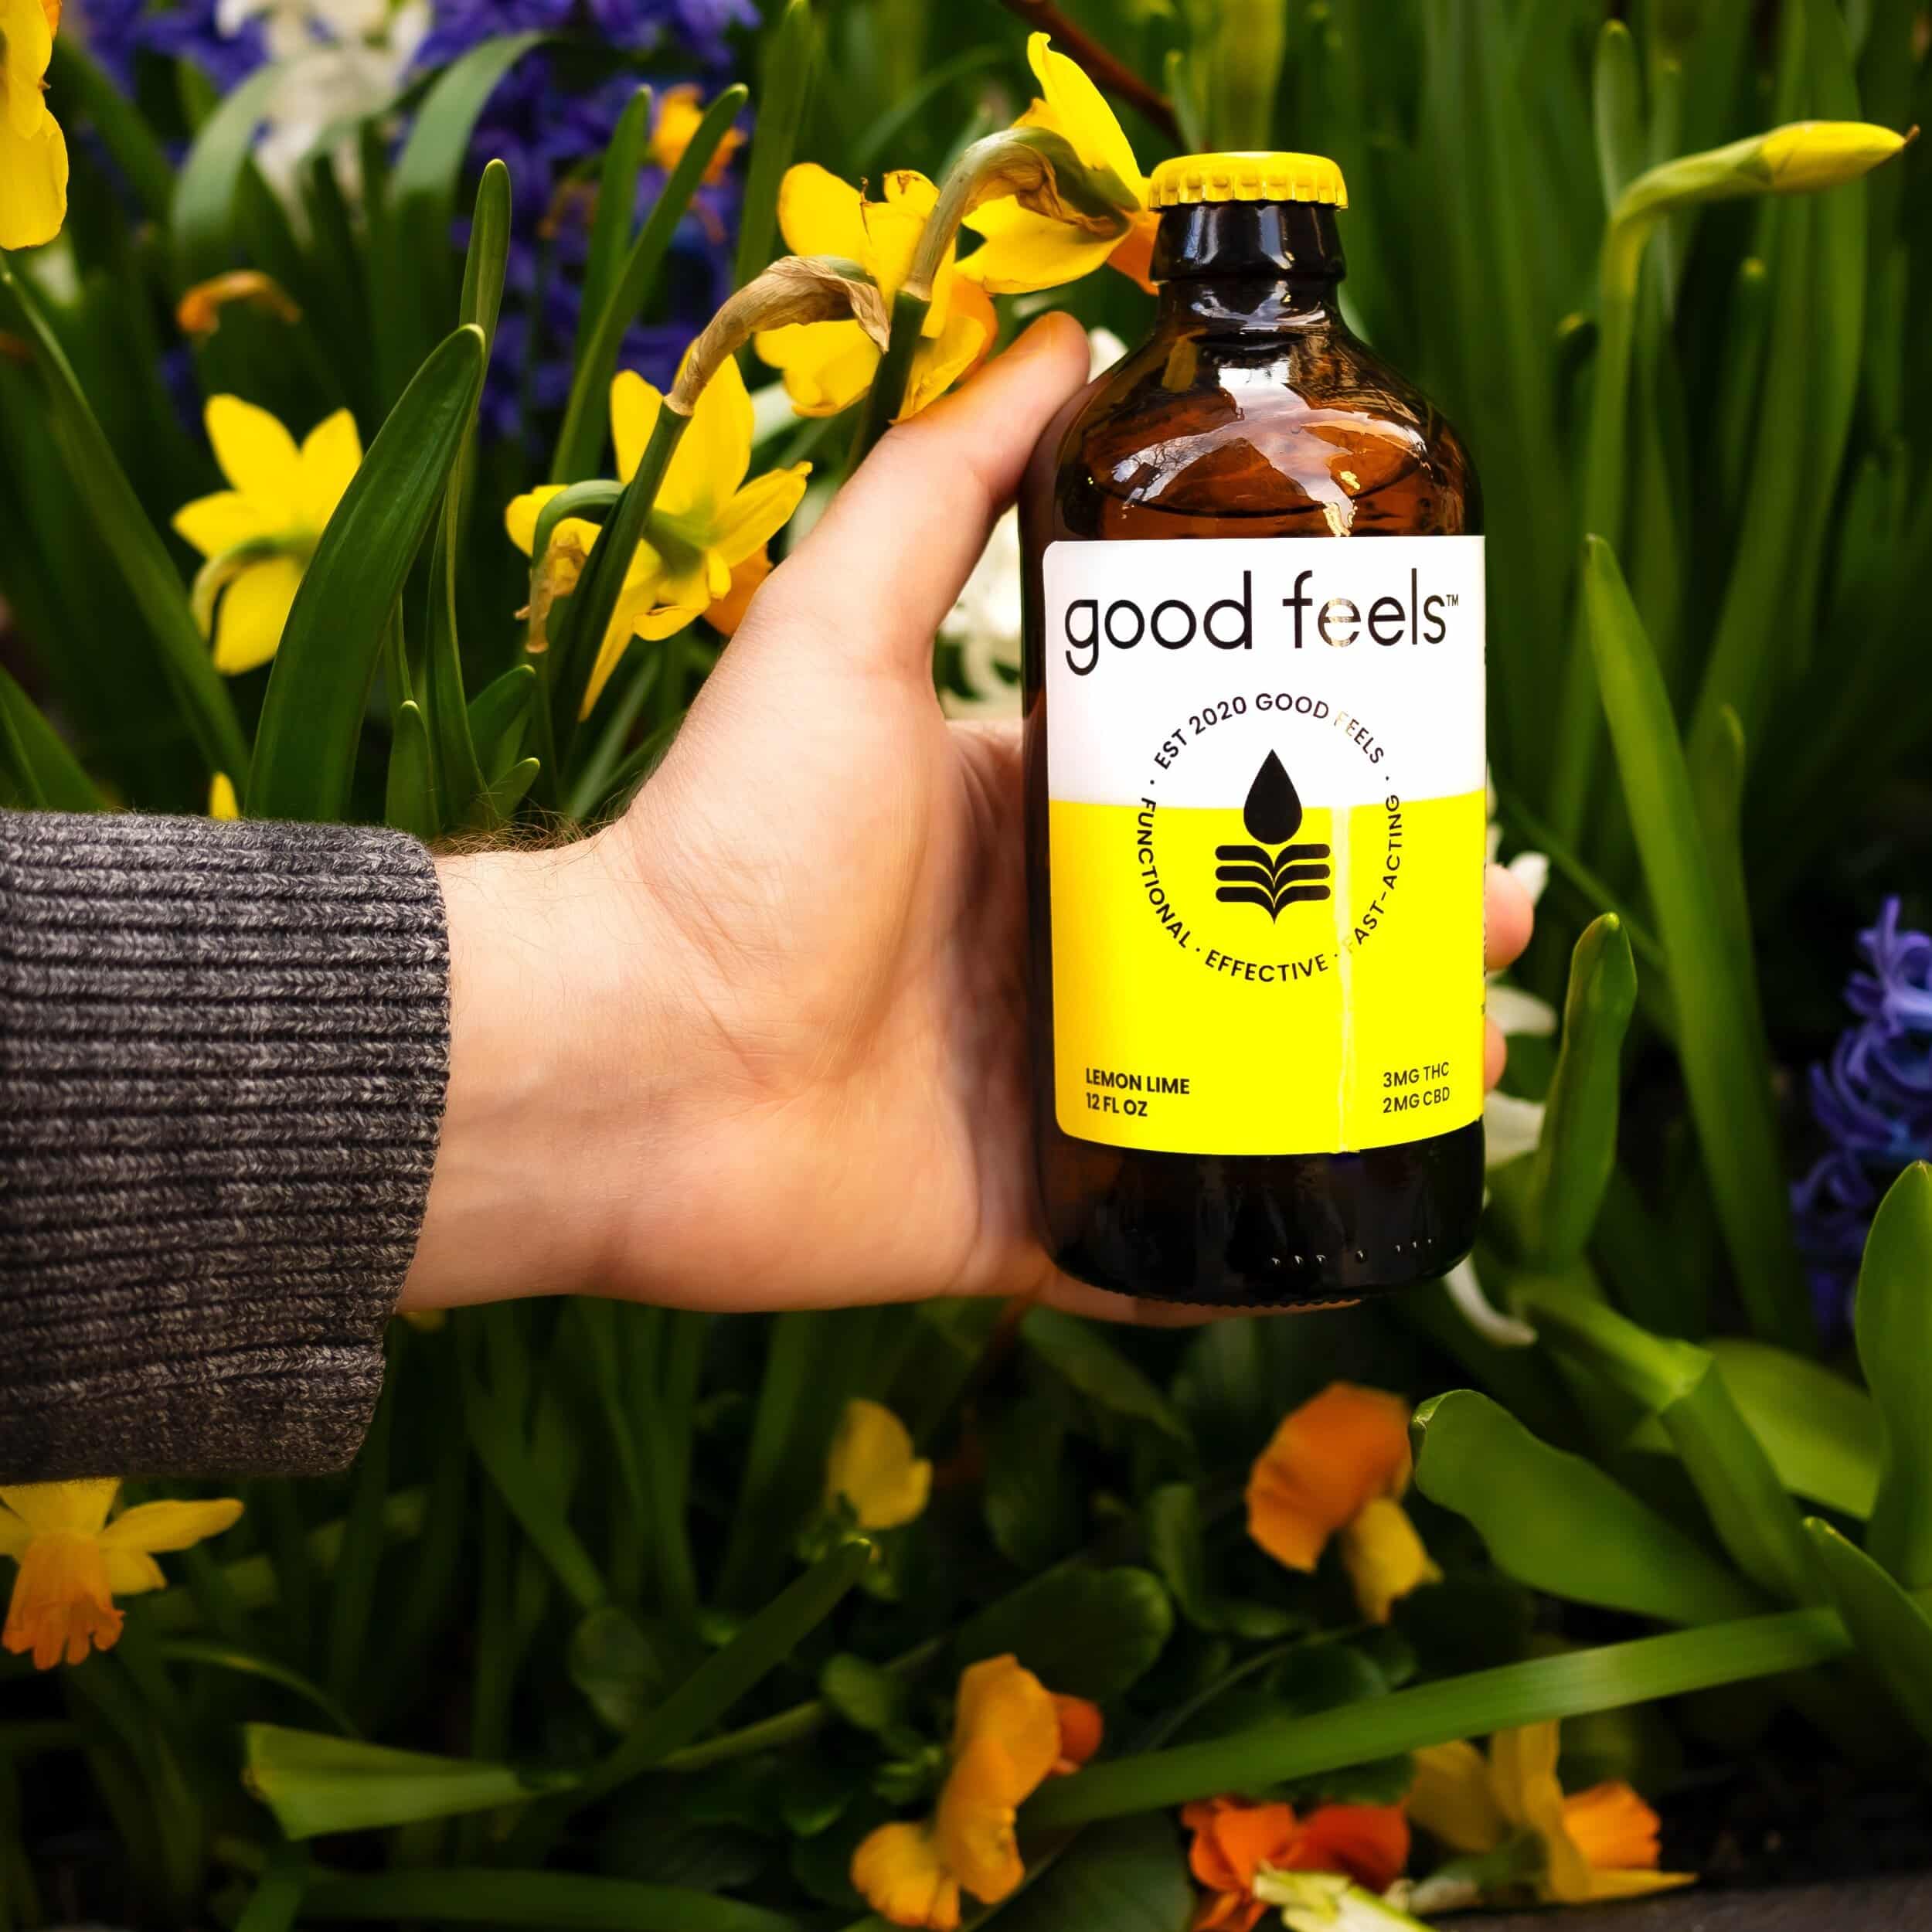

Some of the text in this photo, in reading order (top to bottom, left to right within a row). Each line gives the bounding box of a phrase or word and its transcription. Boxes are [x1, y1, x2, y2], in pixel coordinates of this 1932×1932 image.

[1065, 570, 1253, 676] good
[1154, 693, 1384, 770] EST 2020 GOOD FEELS
[1137, 797, 1194, 948] FUNCTIONAL
[1204, 949, 1328, 982] EFFECTIVE
[1086, 1068, 1190, 1094] LEMON LIME
[1383, 1062, 1450, 1088] 3MG THC
[1086, 1092, 1148, 1117] 12 FL OZ
[1383, 1087, 1451, 1113] 2MG CBD
